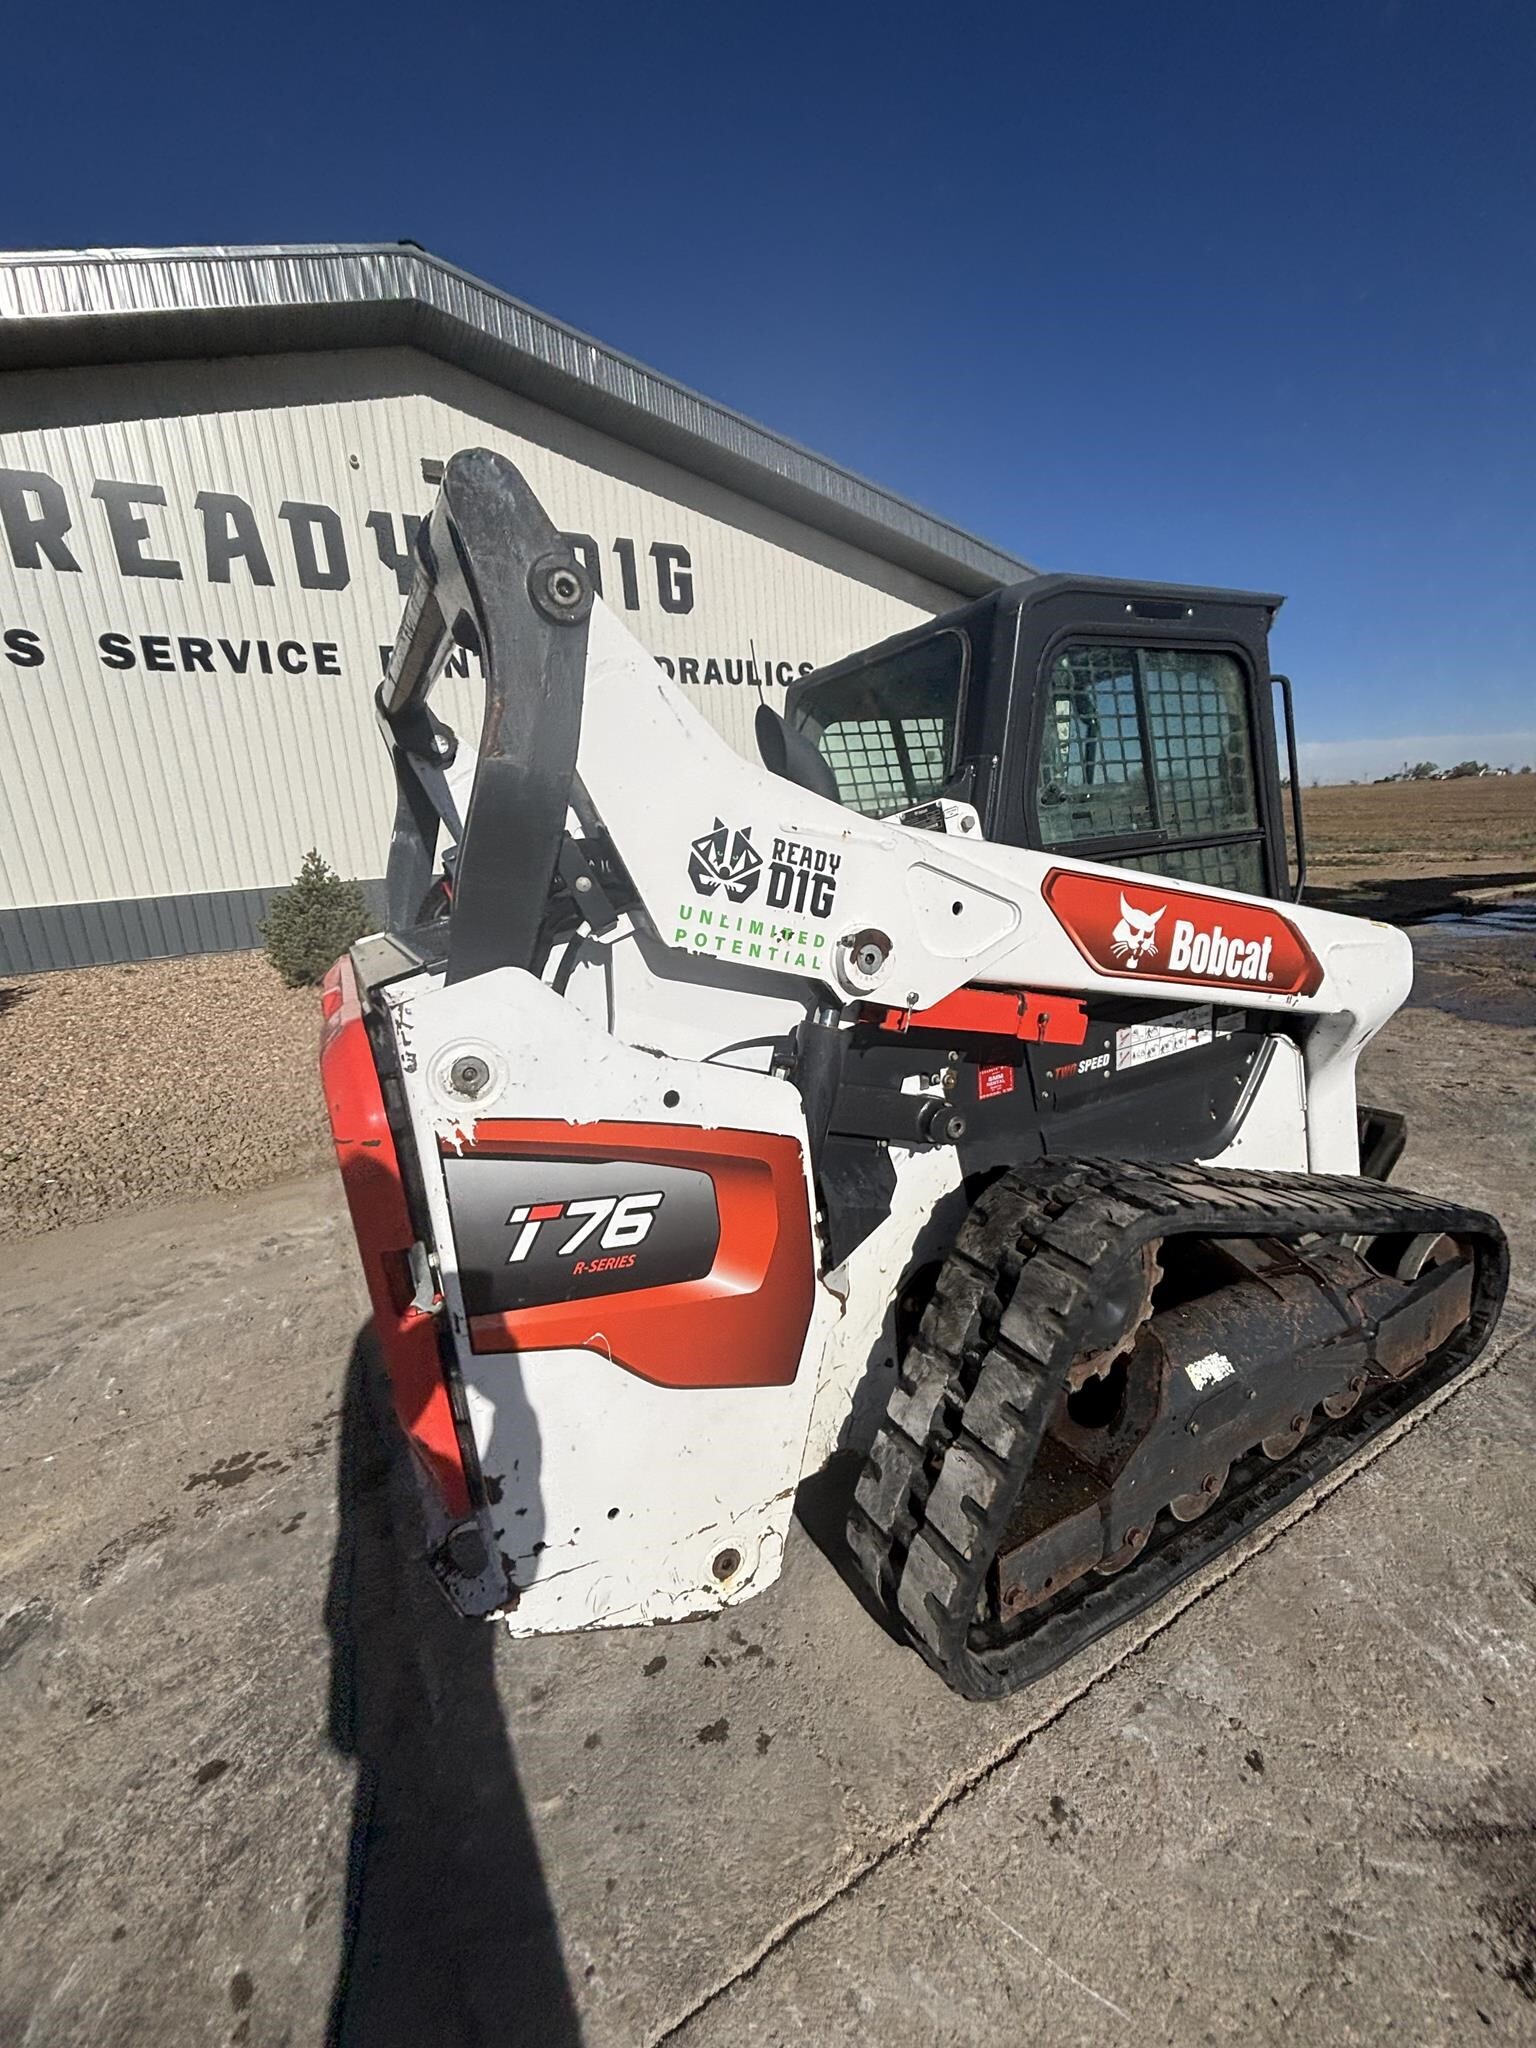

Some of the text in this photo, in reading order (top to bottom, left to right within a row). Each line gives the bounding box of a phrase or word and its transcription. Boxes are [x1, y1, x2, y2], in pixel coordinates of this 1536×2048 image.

[0, 468, 421, 595] READY
[99, 632, 342, 675] SERVICE
[771, 838, 841, 875] READY
[766, 861, 837, 919] DIG
[679, 904, 825, 948] UNLIMITED
[674, 928, 821, 970] POTENTIAL
[1168, 919, 1273, 982] Bobcat
[1078, 1053, 1110, 1074] SPEED
[505, 1191, 664, 1264] T76
[572, 1254, 637, 1275] R-SERIES
